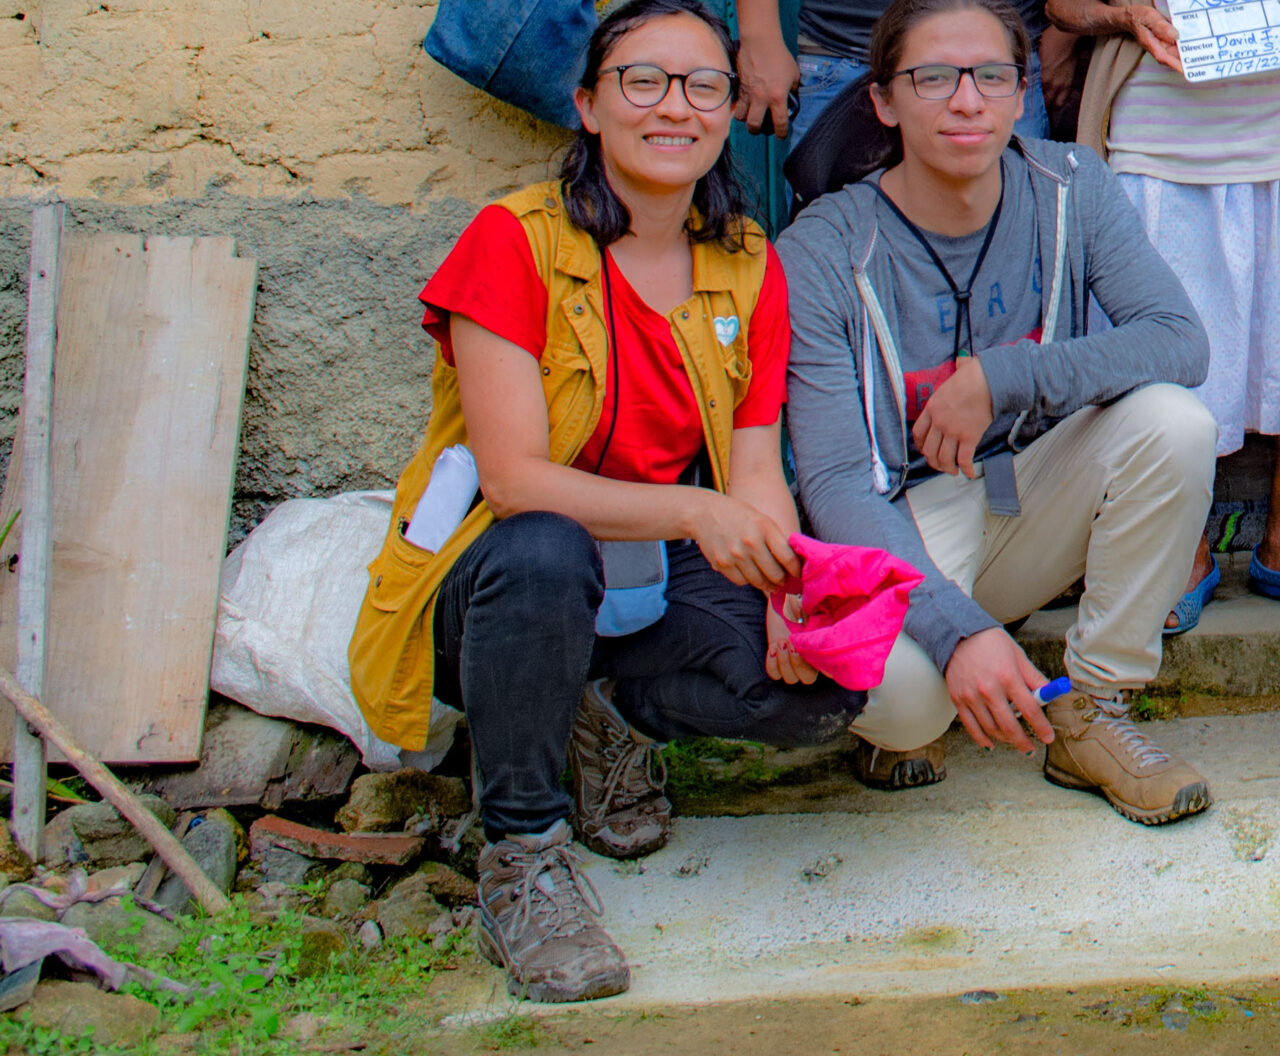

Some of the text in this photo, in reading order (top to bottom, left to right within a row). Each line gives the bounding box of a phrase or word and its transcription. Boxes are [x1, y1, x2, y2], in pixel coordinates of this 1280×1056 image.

[1216, 33, 1257, 49] David
[1181, 42, 1213, 53] Director
[1184, 55, 1214, 64] Camera
[1217, 49, 1258, 60] Pierre
[1187, 70, 1206, 79] Date
